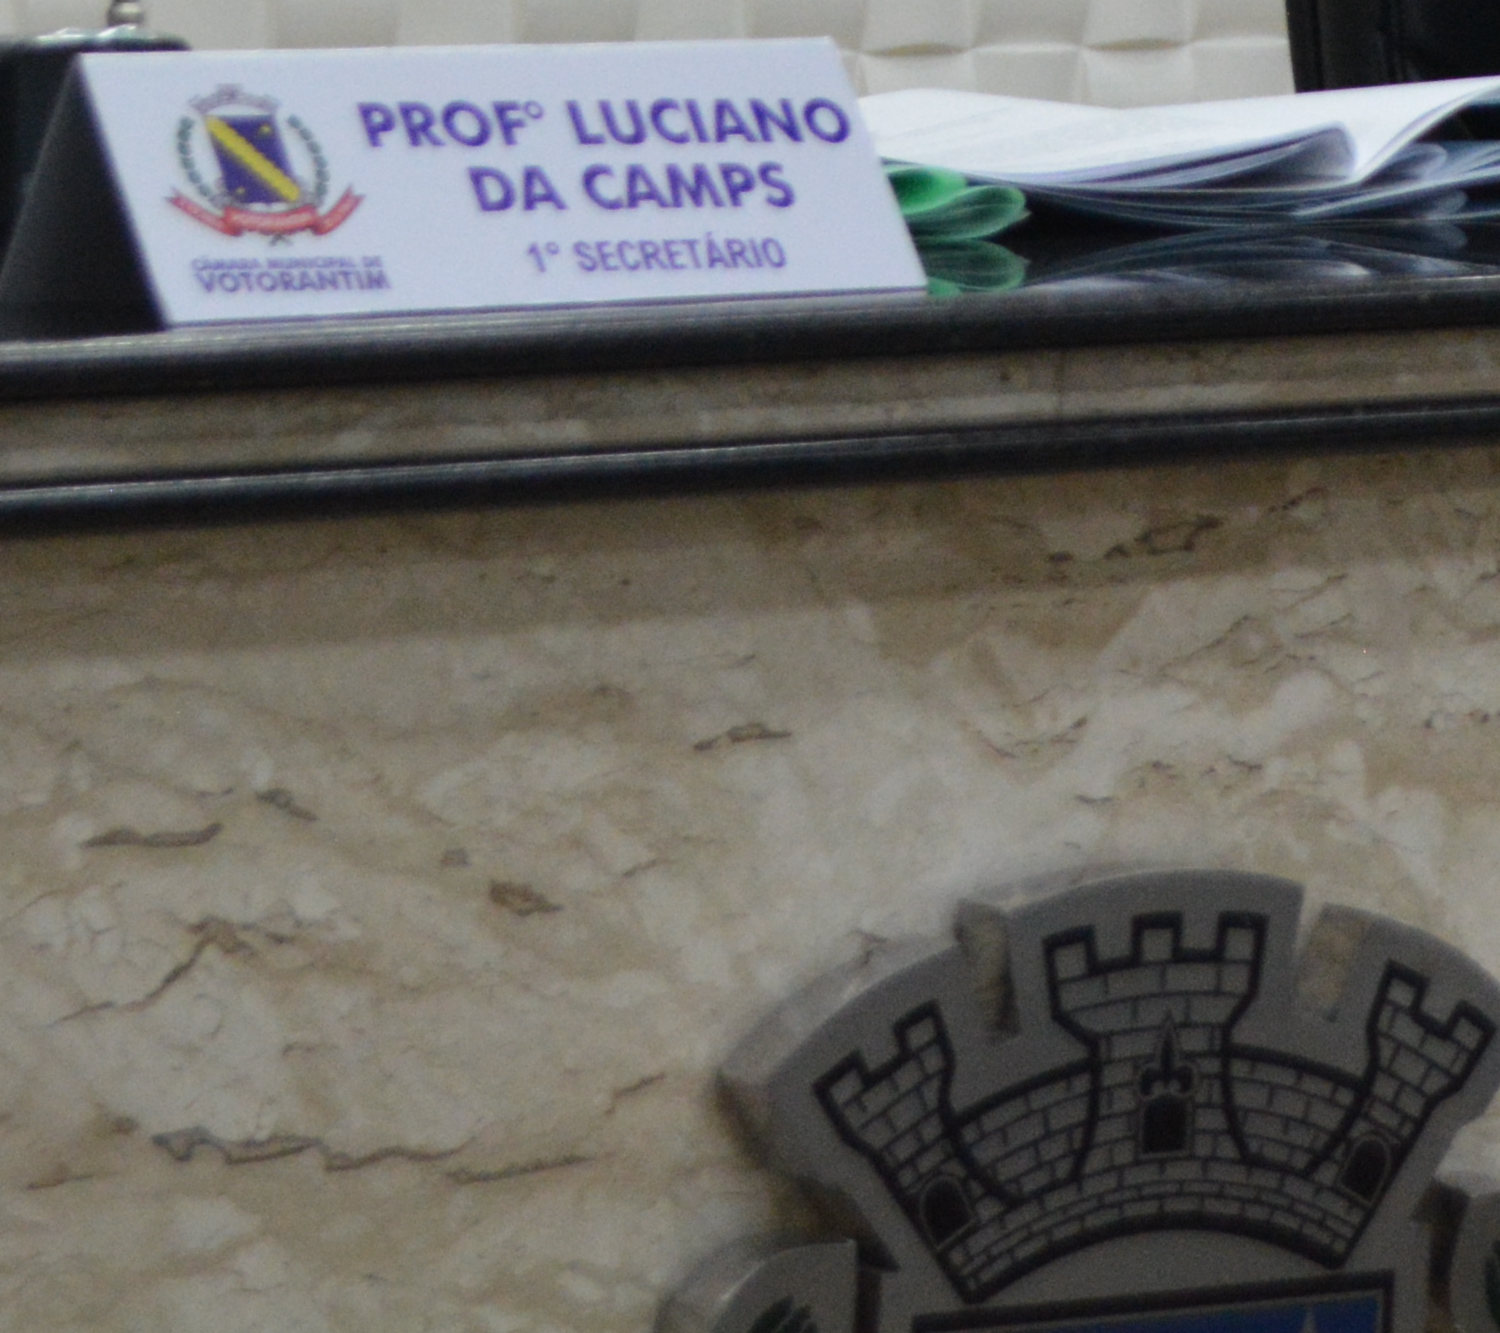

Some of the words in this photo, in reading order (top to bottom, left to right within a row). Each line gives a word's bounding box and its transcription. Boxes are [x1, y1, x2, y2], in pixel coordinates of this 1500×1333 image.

[566, 96, 853, 145] LUCIANO
[468, 164, 568, 212] DA
[581, 161, 796, 210] CAMPS
[572, 232, 787, 272] SECRETÁRIO
[193, 269, 392, 293] VOTORANTIM
